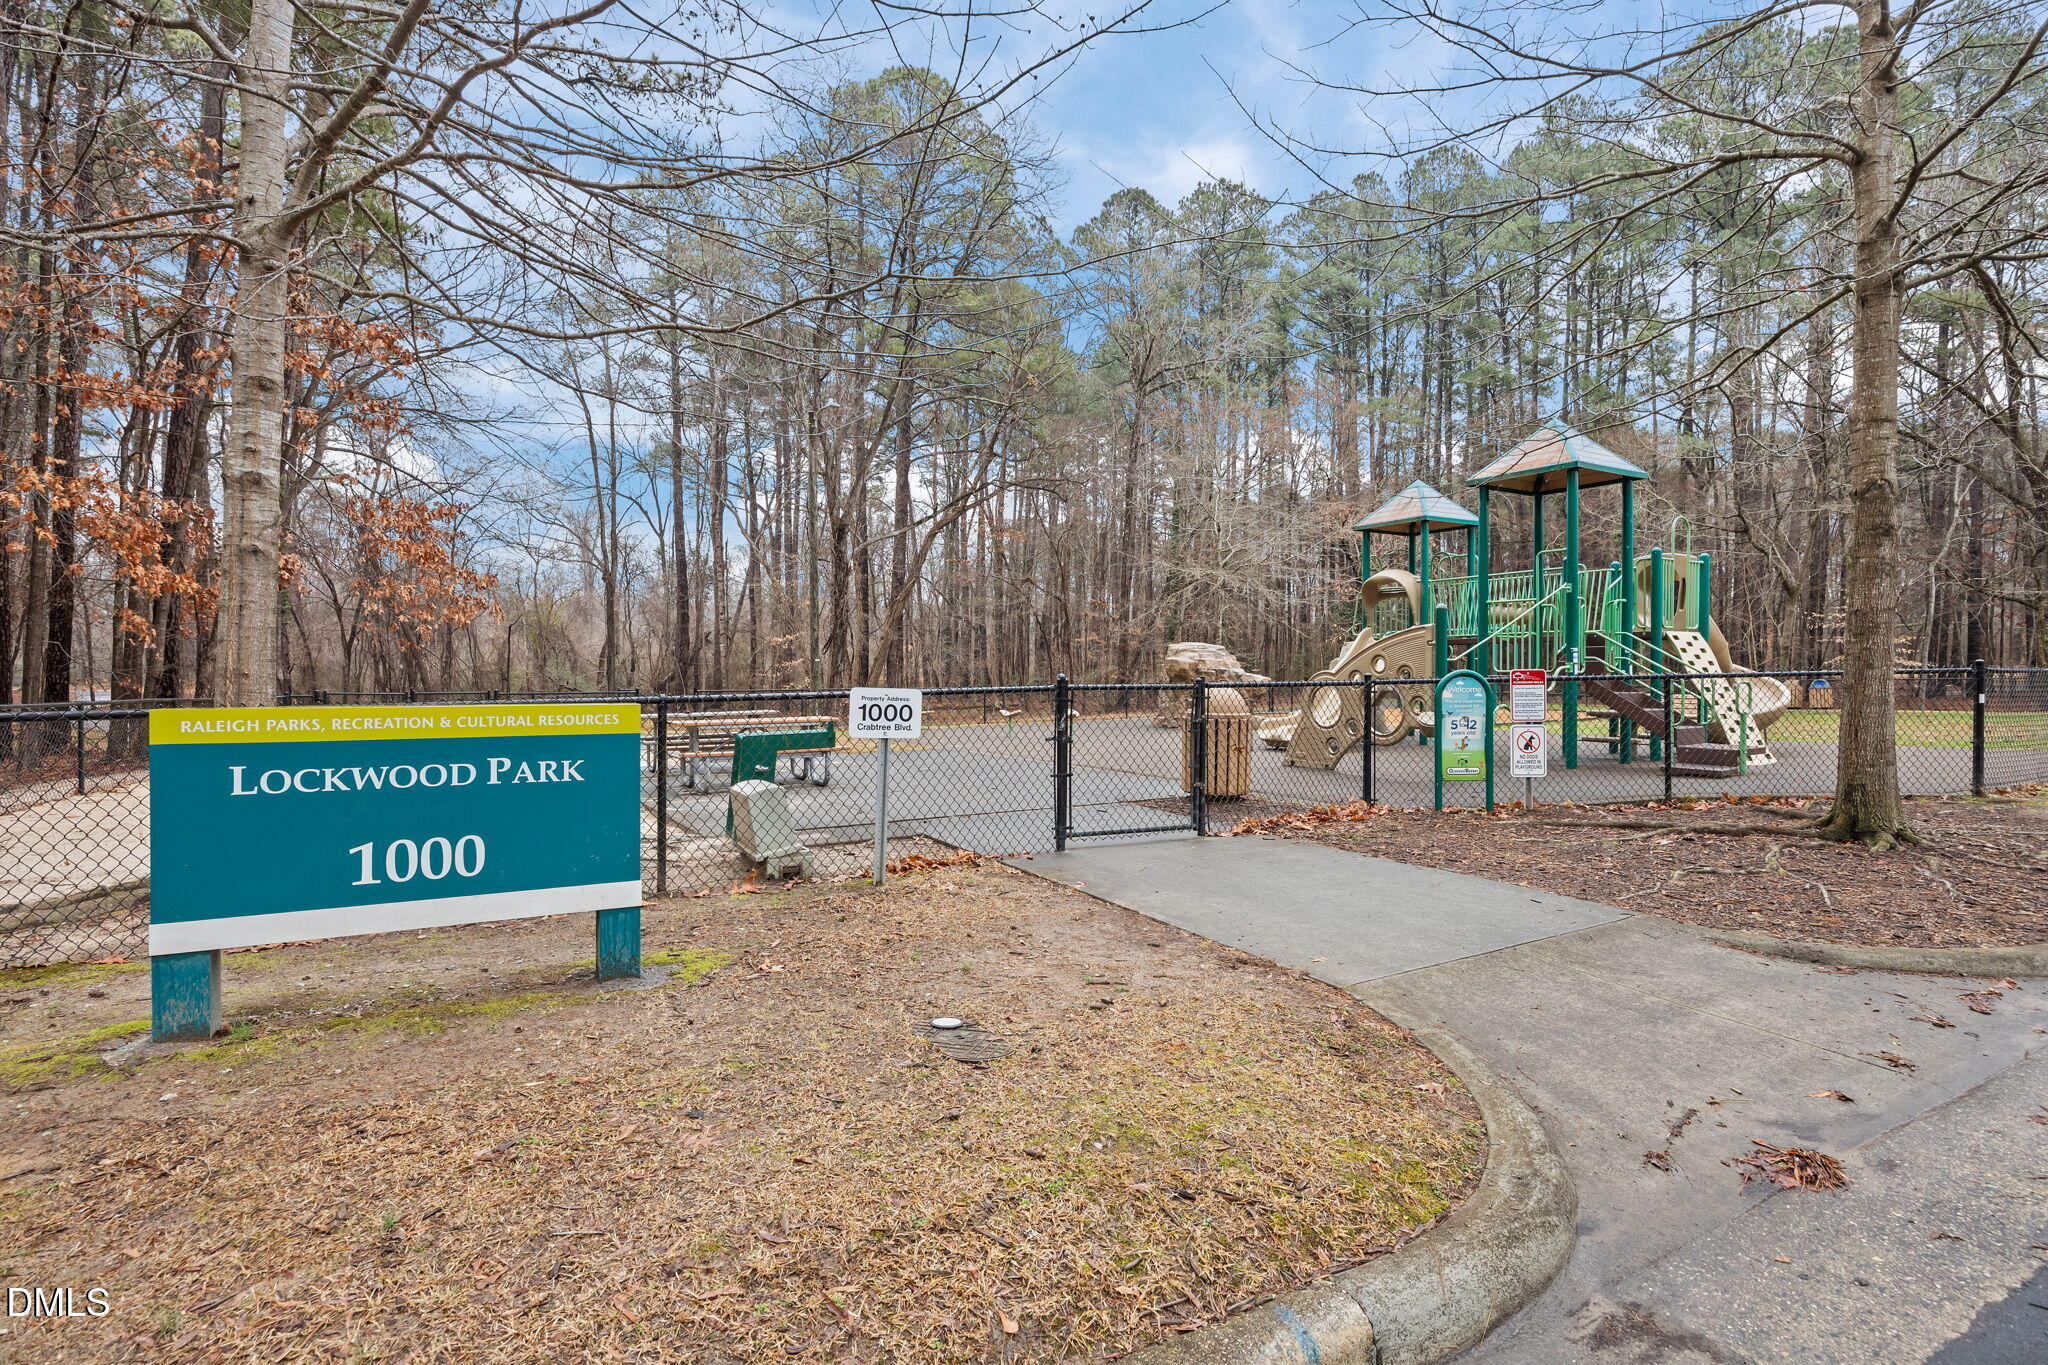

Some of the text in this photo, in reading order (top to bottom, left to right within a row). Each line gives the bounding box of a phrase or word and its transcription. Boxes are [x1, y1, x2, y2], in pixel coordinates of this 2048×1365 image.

[858, 704, 912, 722] 1000
[180, 714, 620, 733] RALEIGH PARKS, RECREATION & CULTURAL RESOURCES
[857, 722, 892, 730] Crabtree
[1450, 720, 1458, 730] 5
[1466, 720, 1477, 730] 12
[229, 758, 585, 796] LOCKWOOD PARK
[349, 835, 486, 886] 1000
